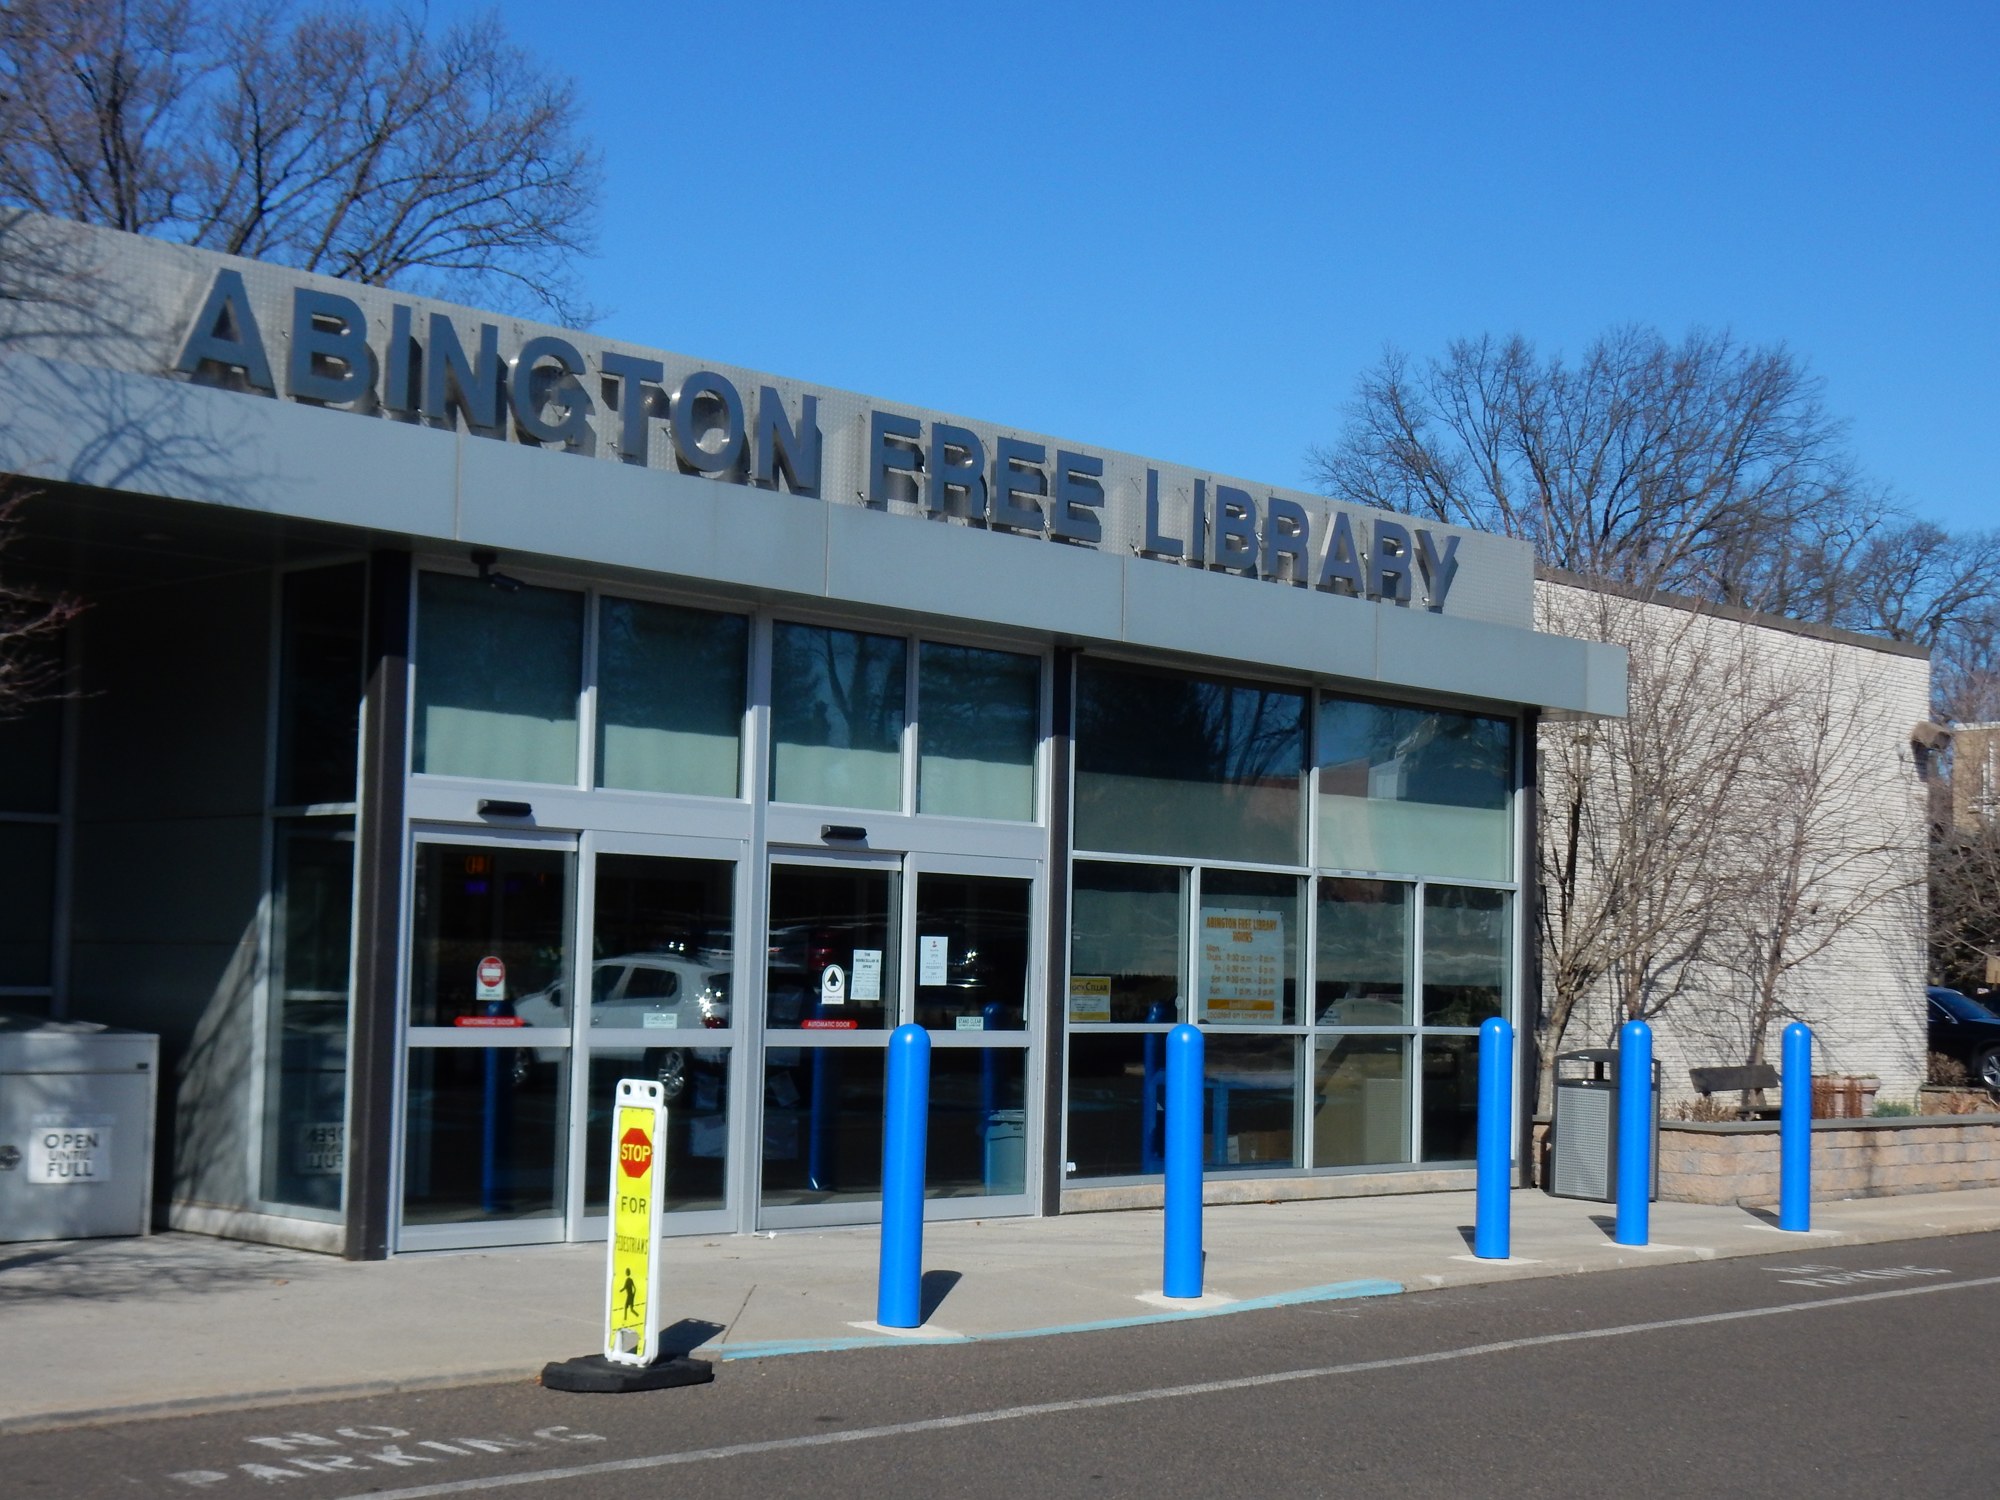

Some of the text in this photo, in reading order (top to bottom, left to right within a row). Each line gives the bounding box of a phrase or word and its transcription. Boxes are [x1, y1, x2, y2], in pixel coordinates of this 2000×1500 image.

[176, 267, 1461, 608] ABINGTON FREE LIBRARY
[44, 1132, 99, 1149] OPEN
[621, 1143, 651, 1162] STOP
[47, 1162, 94, 1177] FULL
[621, 1196, 647, 1214] FOR
[615, 1233, 648, 1255] PEDESTRIANS
[245, 1425, 412, 1451] NO
